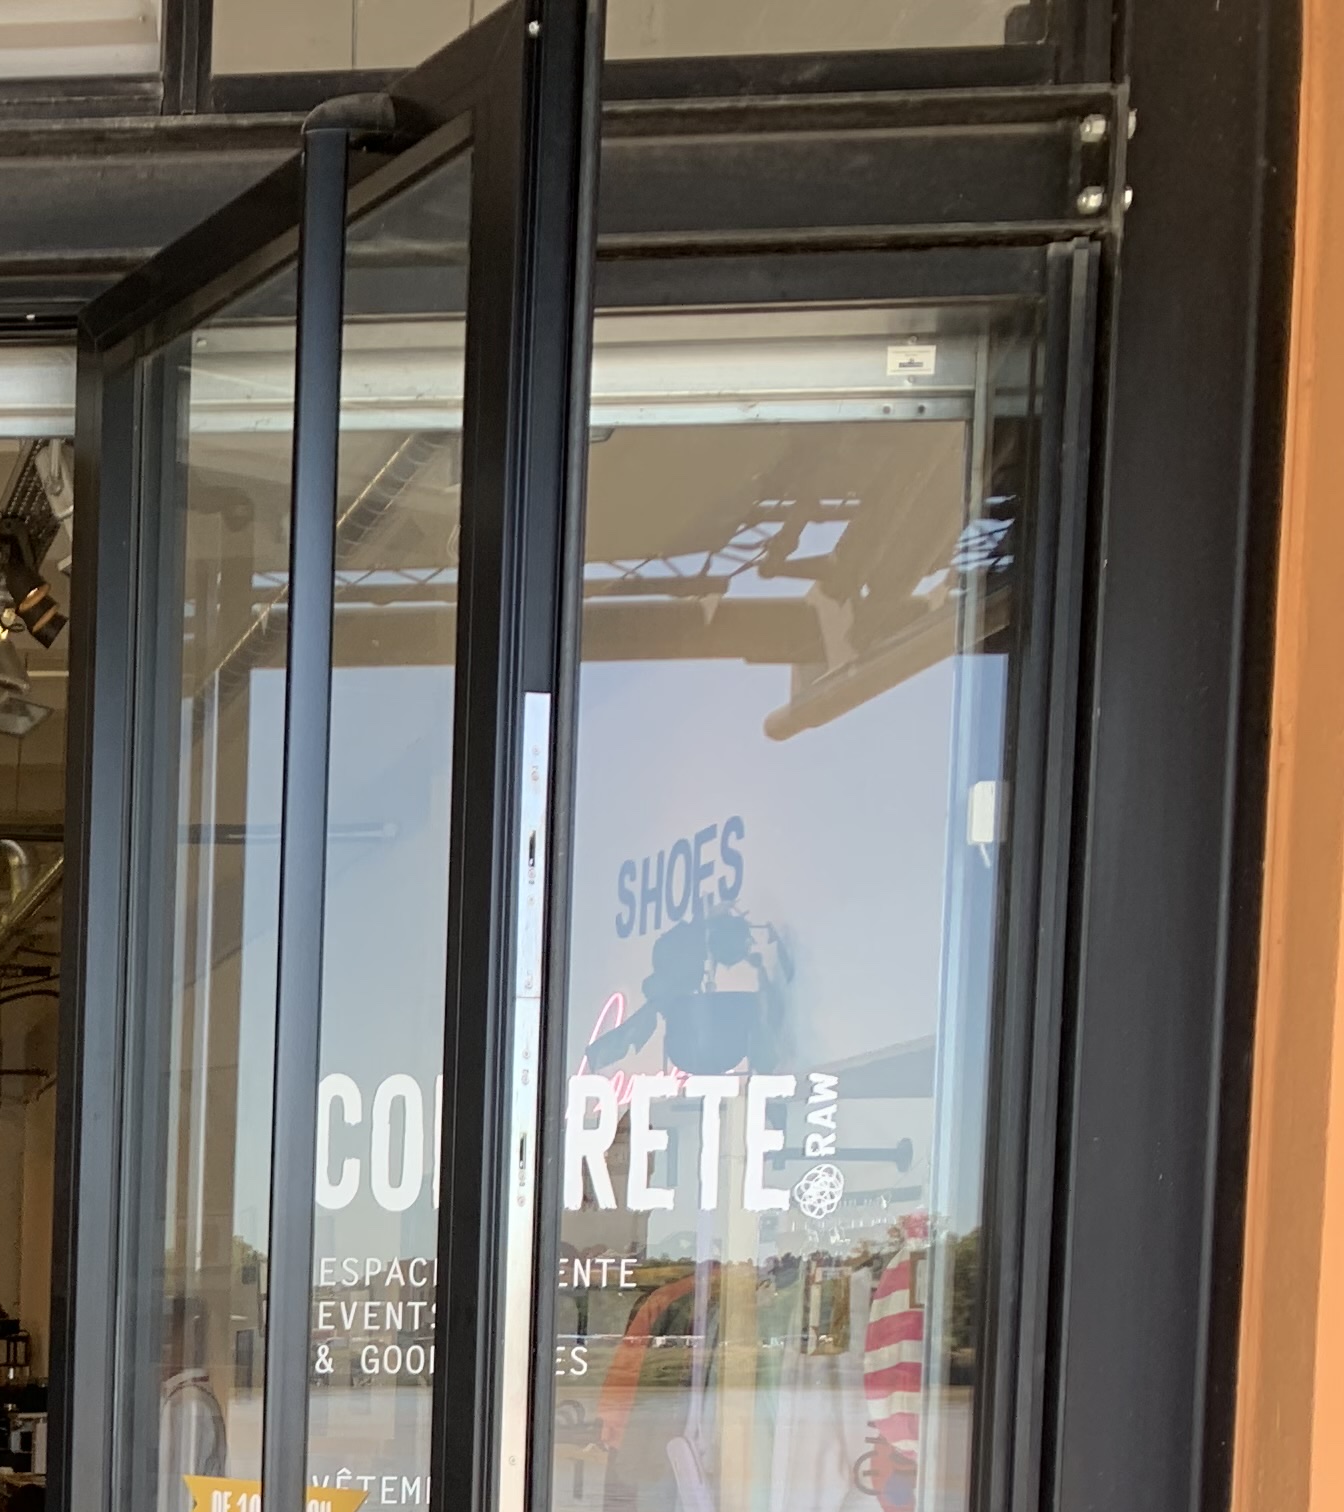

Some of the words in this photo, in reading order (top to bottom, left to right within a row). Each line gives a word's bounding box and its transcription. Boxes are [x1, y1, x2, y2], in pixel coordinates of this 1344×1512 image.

[615, 815, 746, 939] SHOES
[315, 1072, 797, 1212] CORETE
[805, 1071, 839, 1156] RAW
[318, 1256, 437, 1288] ESPAC
[557, 1257, 638, 1289] ENTE
[314, 1344, 335, 1375] &
